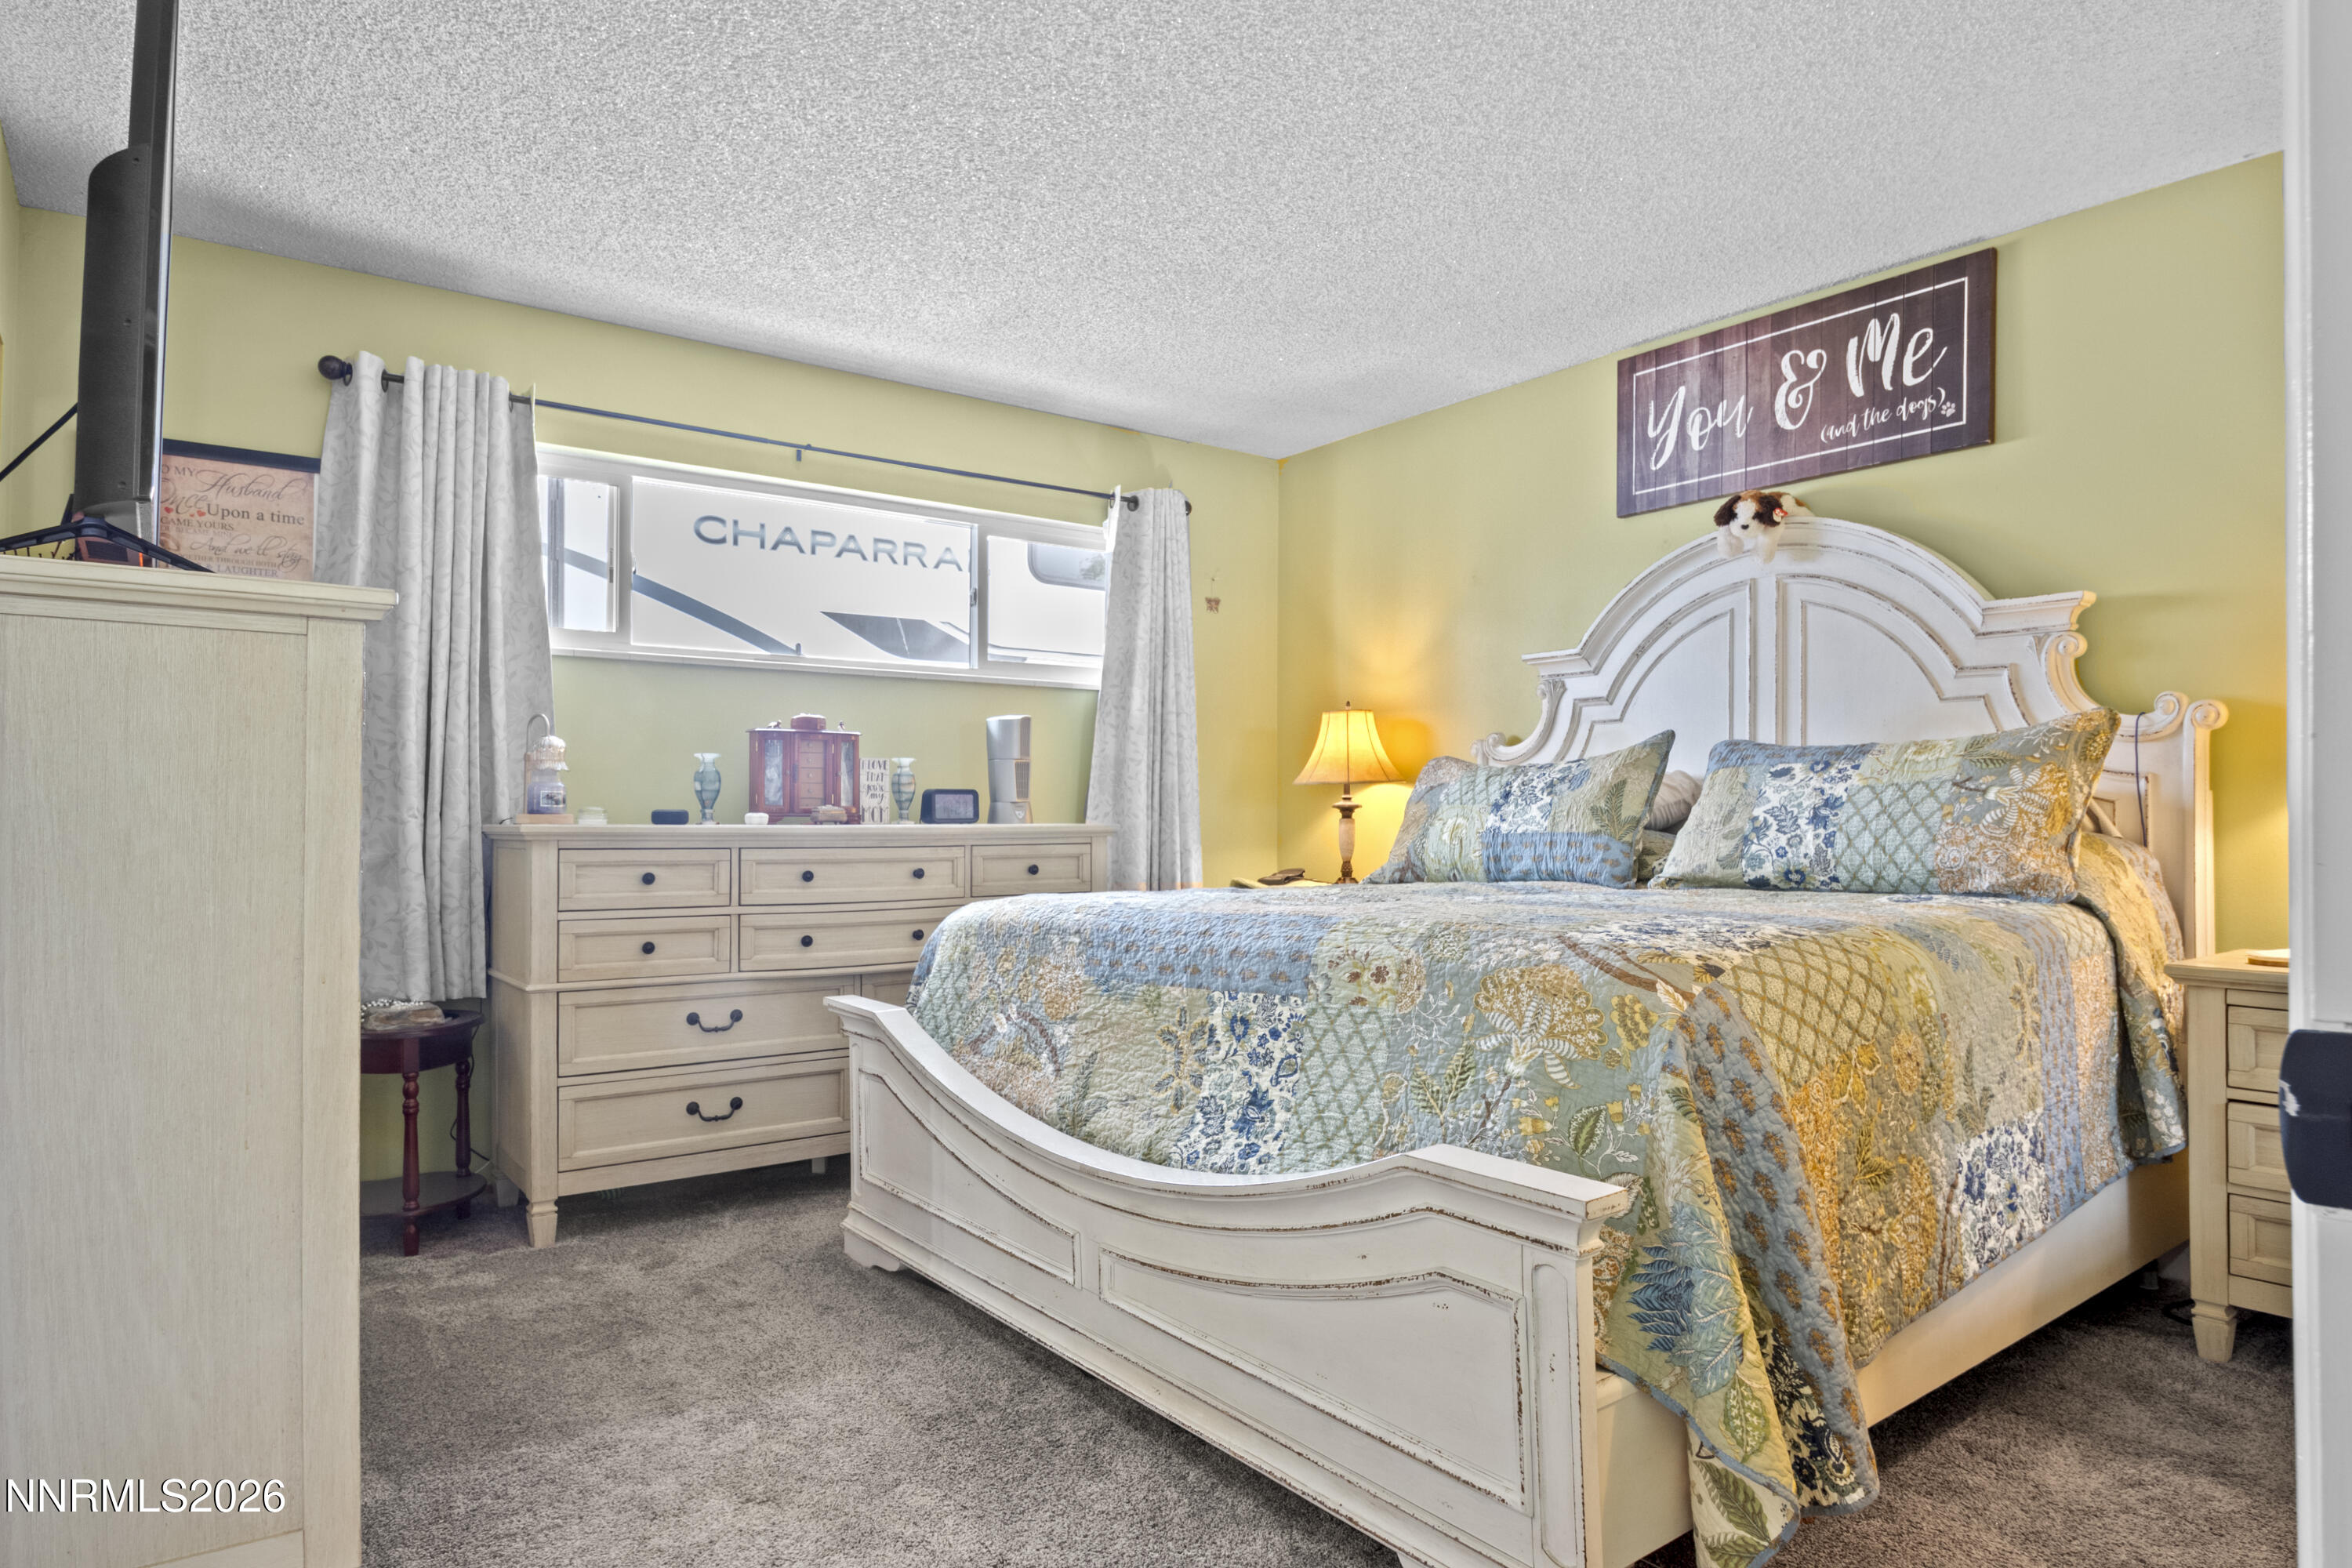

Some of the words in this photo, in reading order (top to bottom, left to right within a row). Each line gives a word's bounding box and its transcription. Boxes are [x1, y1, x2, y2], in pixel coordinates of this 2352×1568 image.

[1647, 386, 1754, 470] You
[1774, 349, 1827, 430] &
[1846, 313, 1947, 397] Me
[1861, 407, 1893, 430] the
[175, 466, 195, 477] MY
[195, 470, 308, 502] Husband
[207, 503, 250, 521] Upon
[256, 512, 265, 521] a
[270, 511, 305, 525] time
[197, 520, 234, 531] YOURS
[693, 514, 971, 572] CHAPARRA
[217, 564, 279, 578] LAUGHTER
[867, 759, 887, 771] LOVE
[861, 804, 890, 823] MOM
